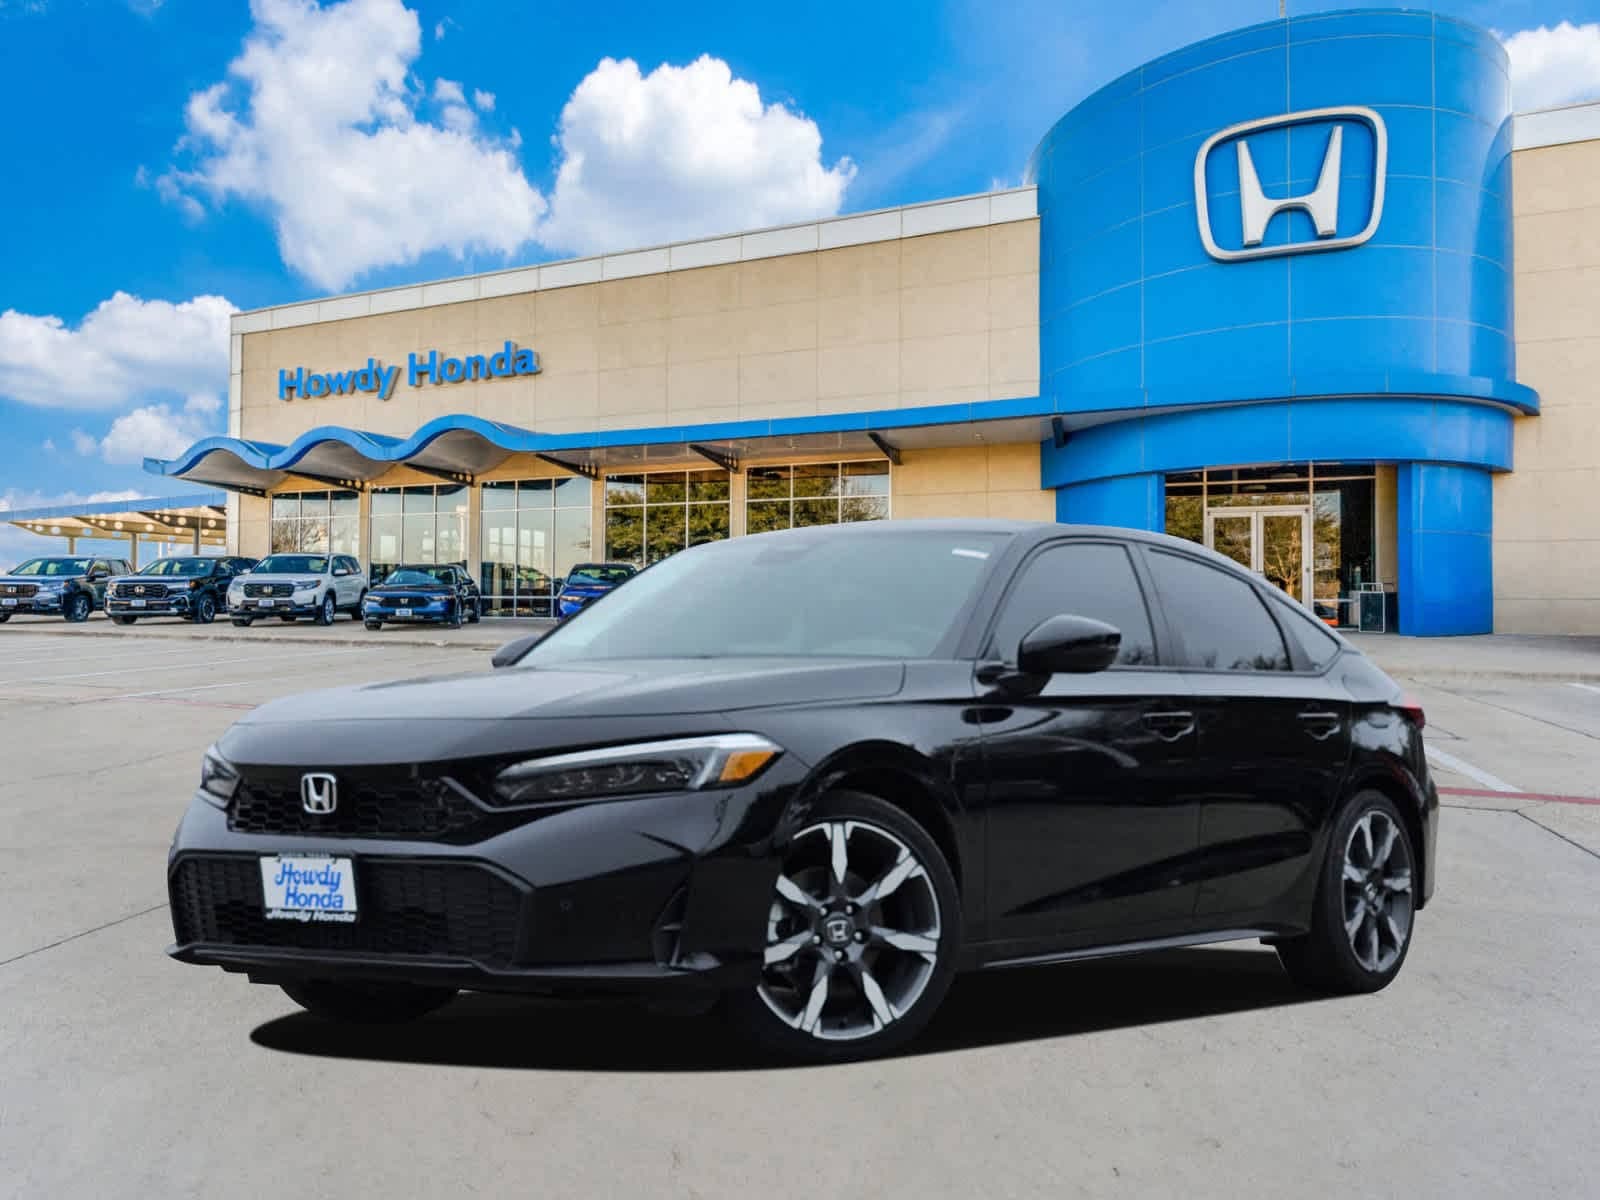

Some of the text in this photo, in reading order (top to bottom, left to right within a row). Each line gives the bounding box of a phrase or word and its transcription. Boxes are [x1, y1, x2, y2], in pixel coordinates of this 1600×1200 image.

[278, 340, 541, 401] Howdy Honda
[274, 863, 342, 893] Howdy
[284, 886, 345, 909] Honda
